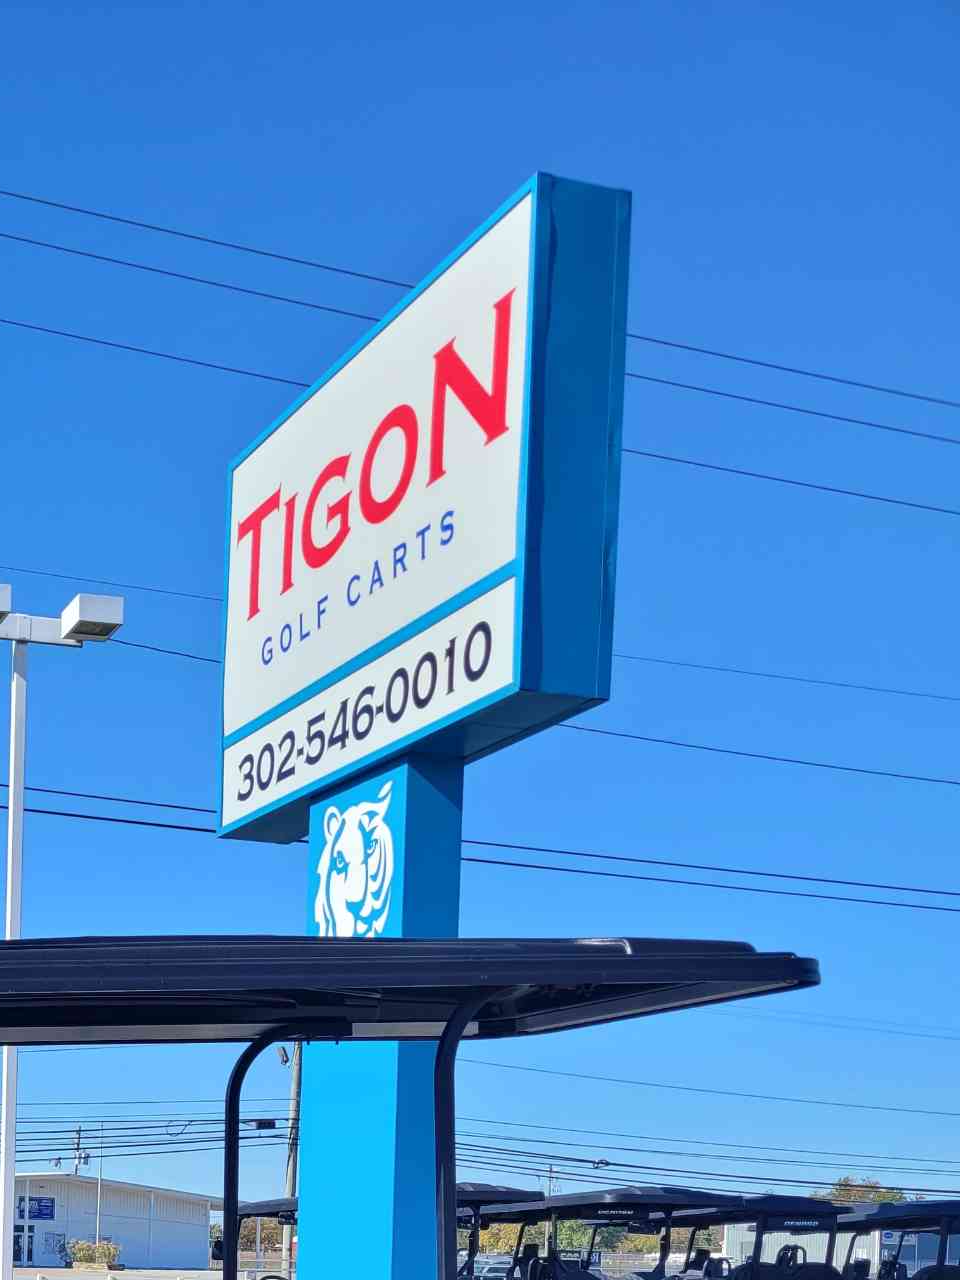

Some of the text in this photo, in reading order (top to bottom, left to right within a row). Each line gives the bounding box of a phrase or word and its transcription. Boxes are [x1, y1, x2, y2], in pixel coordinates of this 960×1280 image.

[237, 288, 516, 621] TIGON
[261, 510, 457, 667] GOLF CARTS
[236, 620, 493, 803] 302-546-0010
